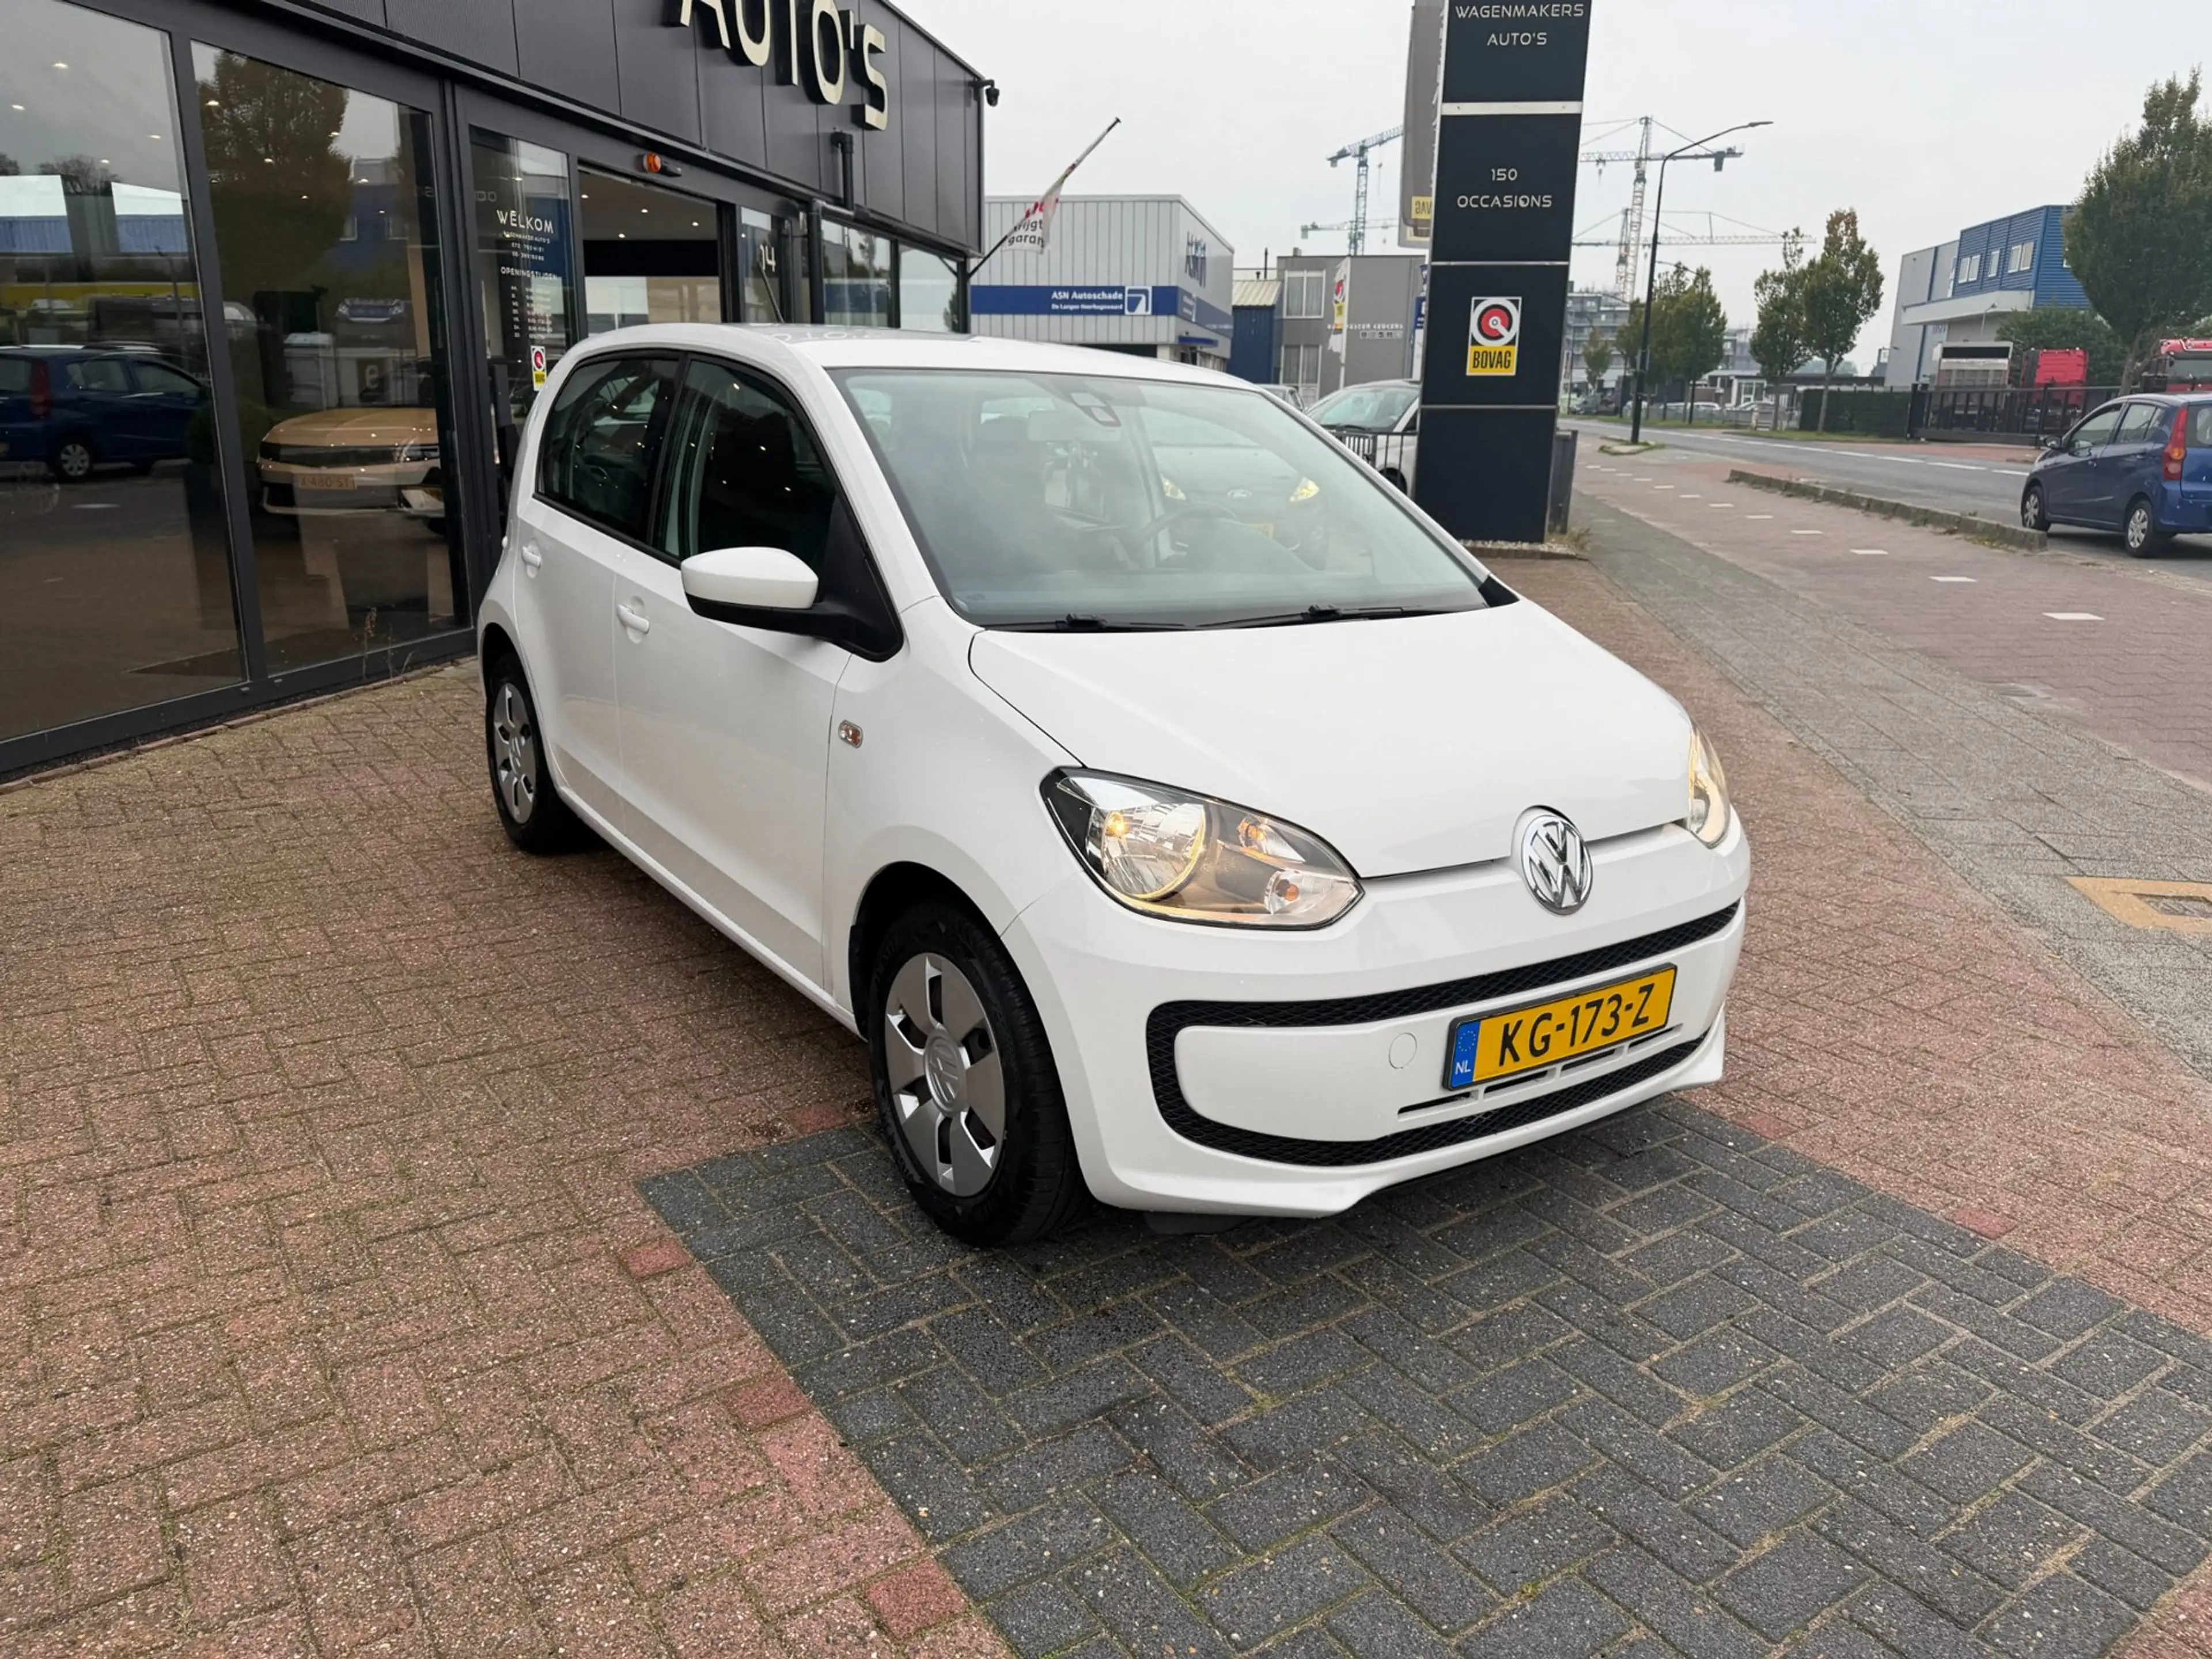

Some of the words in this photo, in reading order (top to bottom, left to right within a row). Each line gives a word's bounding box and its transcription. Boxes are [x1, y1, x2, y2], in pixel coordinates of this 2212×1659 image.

[1455, 3, 1584, 19] WAGENMAKERS
[1486, 32, 1548, 46] AUTO'S
[1491, 168, 1518, 181] 150
[1457, 195, 1552, 208] OCCASIONS
[496, 209, 554, 234] WELKOM
[760, 244, 776, 272] 14
[1051, 291, 1069, 300] ASN
[1071, 290, 1123, 300] Autoschade
[1472, 350, 1512, 369] BOVAG
[1499, 983, 1655, 1066] KG-173-Z
[1455, 1061, 1472, 1075] NL
